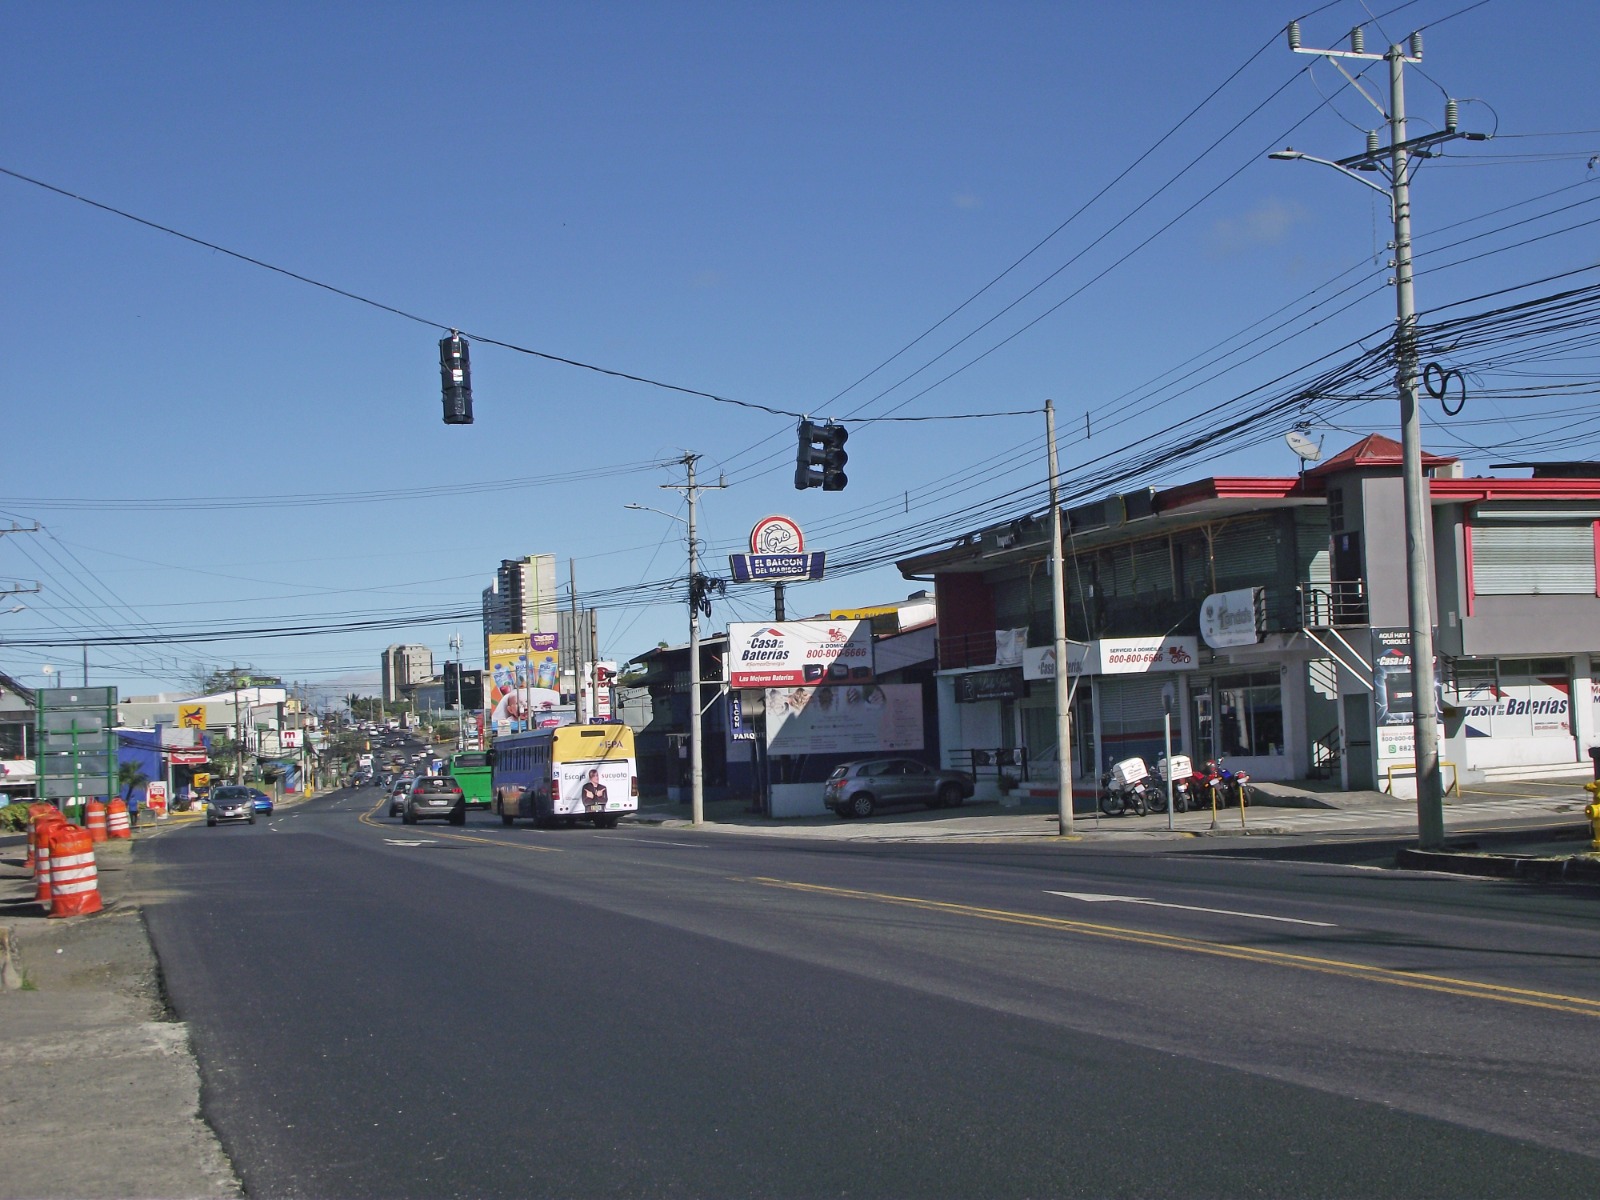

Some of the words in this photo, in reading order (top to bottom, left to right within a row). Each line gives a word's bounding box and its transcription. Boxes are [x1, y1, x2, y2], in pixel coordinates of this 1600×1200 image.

[754, 559, 764, 567] EL
[766, 558, 803, 567] BALCON
[755, 567, 768, 575] DEL
[769, 566, 803, 574] MARISCO
[750, 637, 778, 649] Casa
[806, 648, 867, 658] 800-800-6666
[1109, 653, 1164, 663] 800-800-6666
[1380, 656, 1399, 666] Casa
[1506, 697, 1568, 716] Baterías
